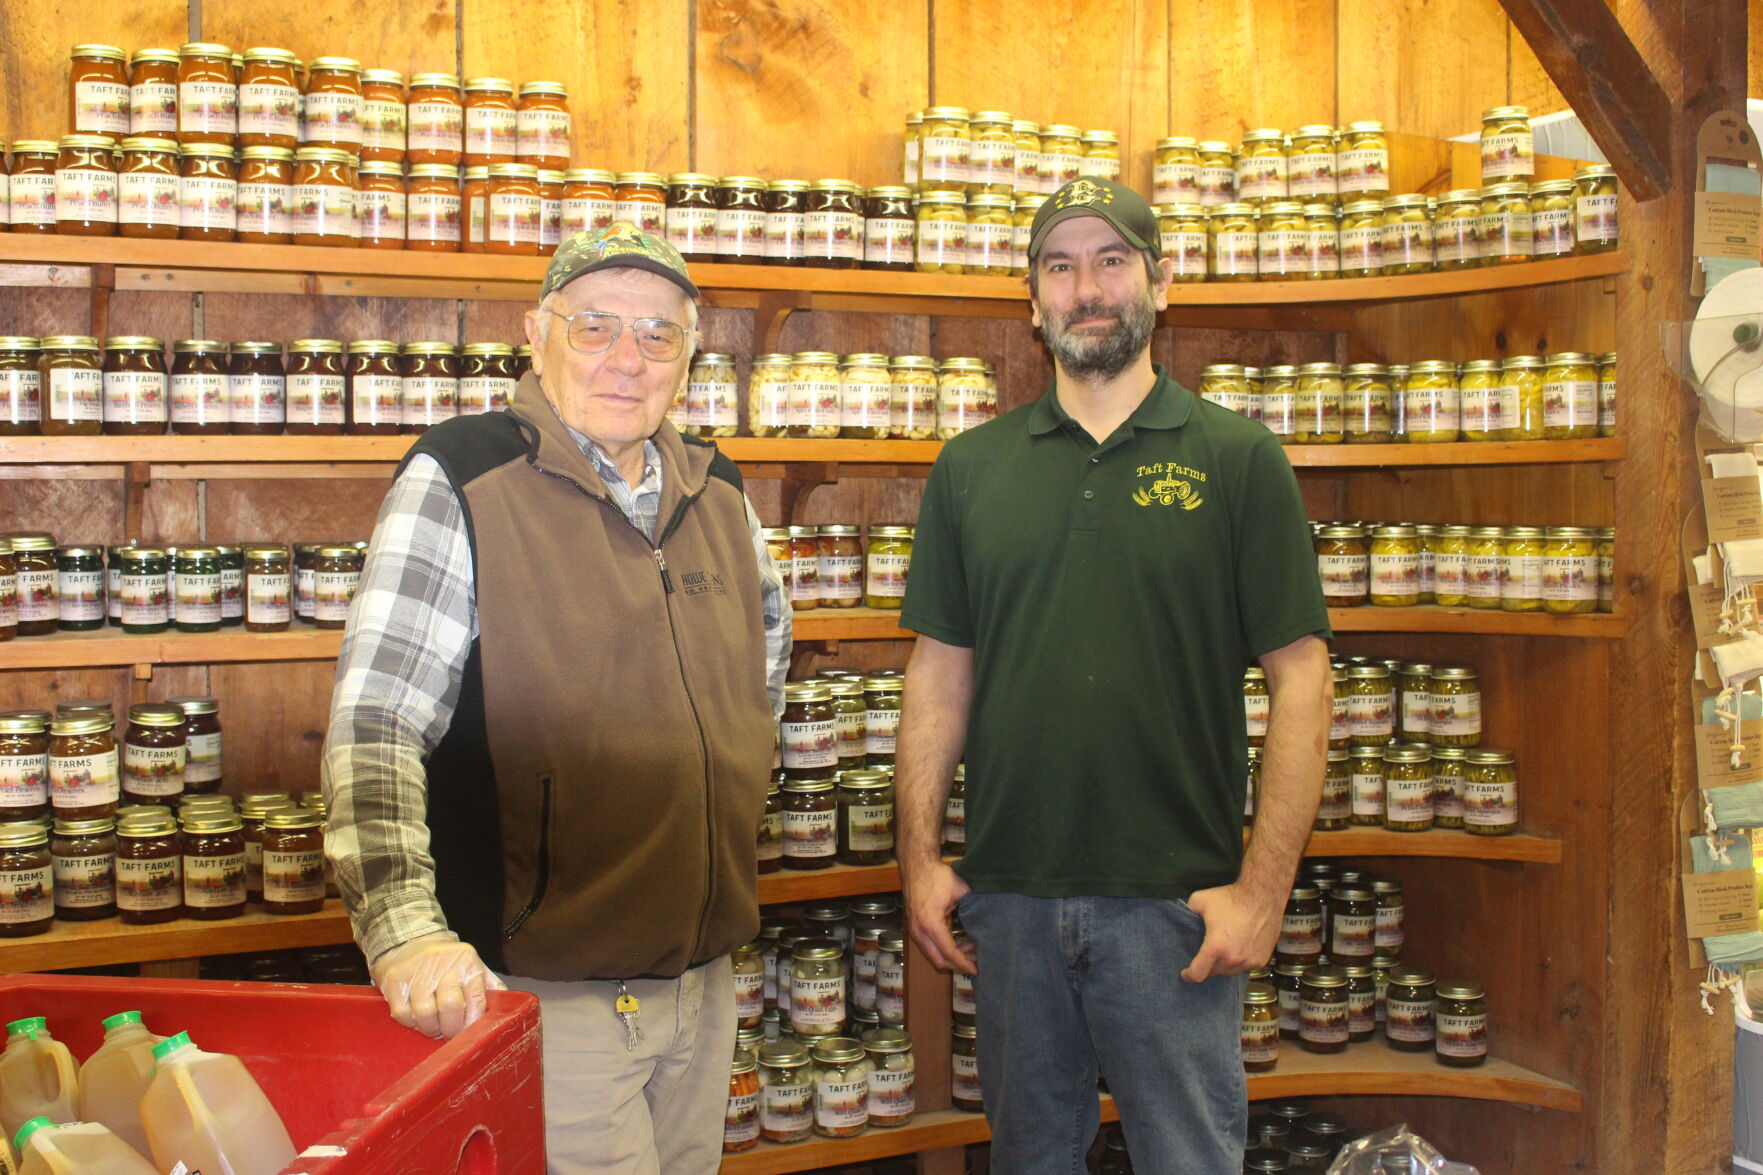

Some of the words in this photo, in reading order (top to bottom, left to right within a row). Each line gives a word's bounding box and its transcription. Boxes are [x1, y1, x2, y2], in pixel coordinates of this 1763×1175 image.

[255, 188, 285, 196] FAMS
[1396, 224, 1422, 232] FAMS
[1436, 221, 1451, 229] AFT
[74, 372, 92, 380] AFT
[370, 378, 389, 386] AFT
[700, 385, 726, 393] FAMS
[900, 386, 919, 394] TAT
[1136, 463, 1162, 477] Taft
[1166, 463, 1206, 481] Farms
[68, 575, 89, 583] TAFT
[124, 579, 142, 587] TAFT
[184, 578, 204, 586] TAFT
[208, 577, 221, 586] FAR
[262, 578, 282, 586] TAFT
[321, 577, 341, 585] TAFT
[811, 722, 834, 732] FARMS
[128, 748, 145, 757] TAFT
[148, 750, 178, 758] FARMS
[17, 757, 45, 767] FARMS
[58, 759, 92, 768] FARMS
[807, 813, 832, 822] FARMS
[272, 855, 293, 863] TAFT
[60, 860, 80, 868] TAFT
[122, 862, 141, 871] TAFT
[145, 860, 175, 871] FARMS
[194, 860, 216, 868] TAFT
[11, 871, 43, 882] FARMS
[794, 981, 811, 990] TAFT
[813, 982, 840, 990] FARMS
[876, 1074, 895, 1082] TAFT
[898, 1072, 914, 1080] FAR
[829, 1084, 850, 1092] TAFT
[853, 1083, 866, 1091] FAR
[778, 1089, 797, 1097] TAFT
